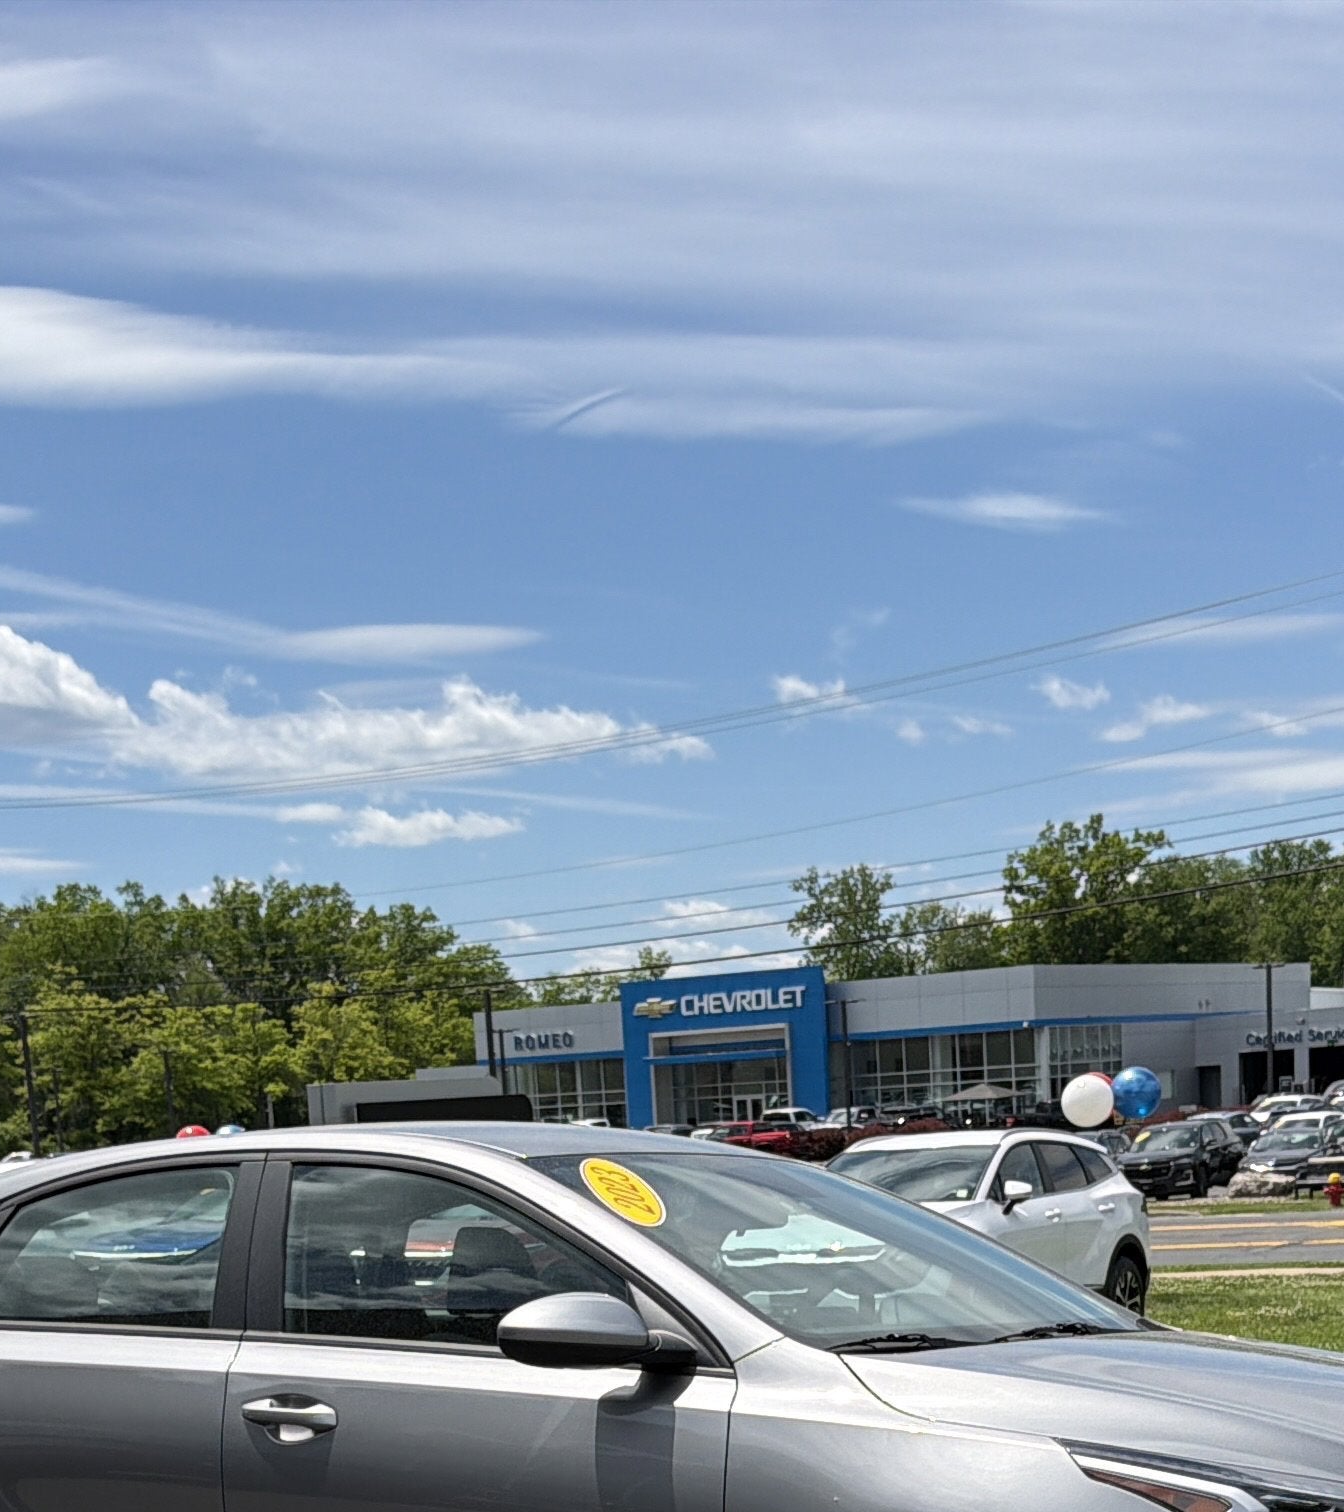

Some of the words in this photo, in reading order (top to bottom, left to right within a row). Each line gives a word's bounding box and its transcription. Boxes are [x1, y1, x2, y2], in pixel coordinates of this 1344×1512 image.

[680, 985, 806, 1016] CHEVROLET
[514, 1030, 575, 1051] ROMEO
[1246, 1030, 1303, 1046] Cerified
[590, 1166, 656, 1216] 2023
